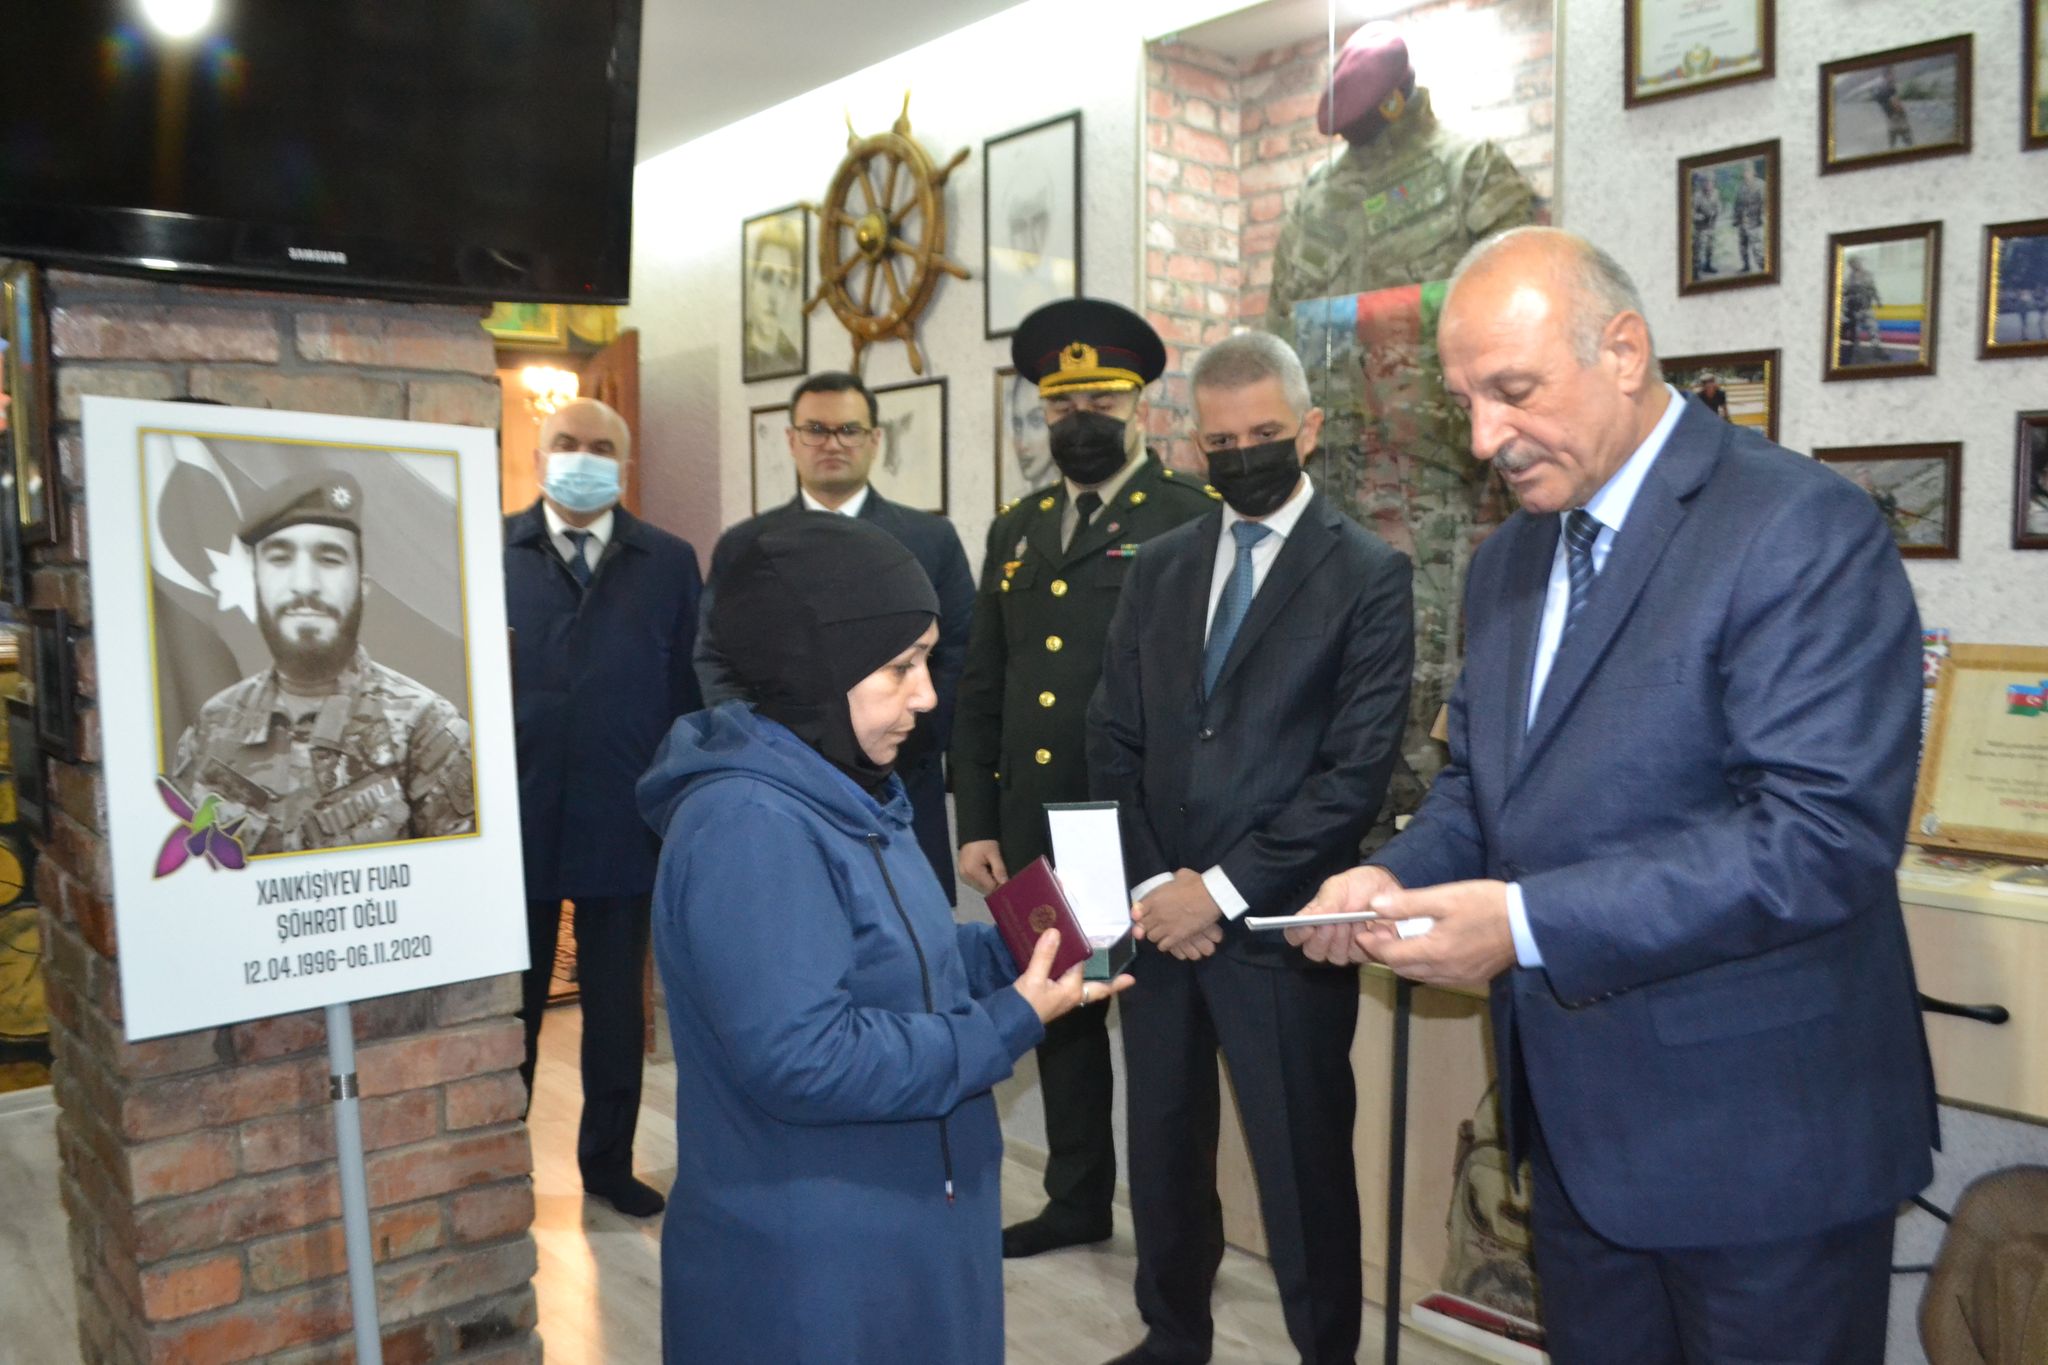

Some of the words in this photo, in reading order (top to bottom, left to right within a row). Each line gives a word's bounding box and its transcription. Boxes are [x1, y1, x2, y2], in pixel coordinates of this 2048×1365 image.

[287, 247, 347, 265] SAMSUNG
[368, 863, 411, 892] FUAD
[353, 898, 398, 930] OĞLU
[244, 935, 432, 985] 12.04.1996-06.11.2020
